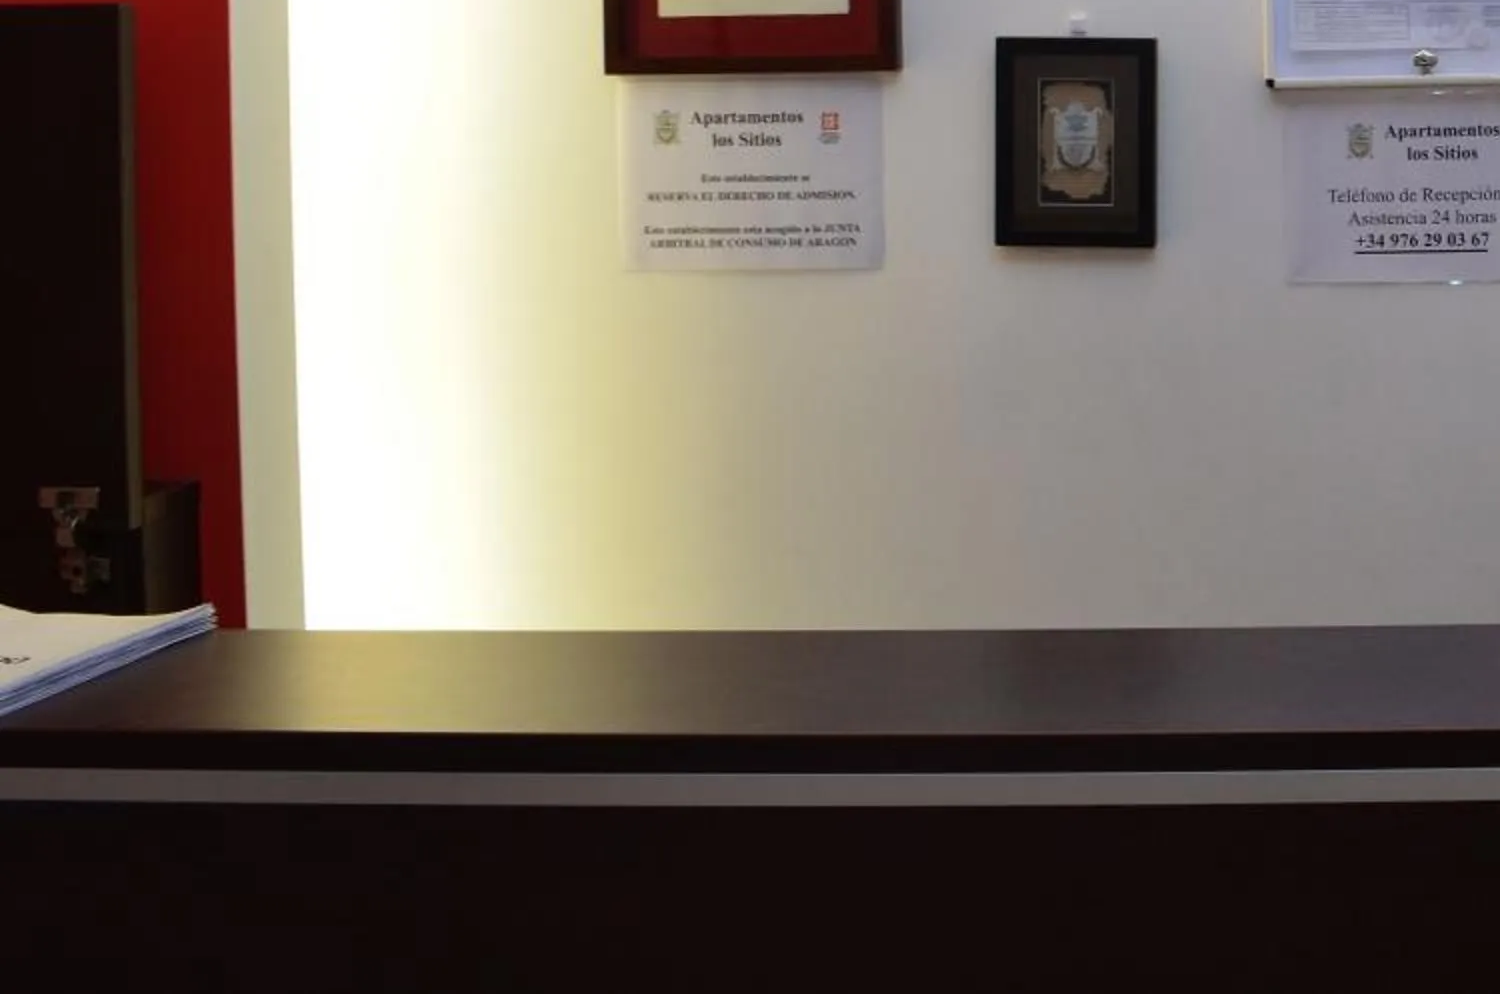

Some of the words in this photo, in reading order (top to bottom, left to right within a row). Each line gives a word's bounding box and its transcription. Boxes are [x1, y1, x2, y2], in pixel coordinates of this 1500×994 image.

[690, 110, 804, 128] Apartamentos
[712, 133, 734, 147] los
[738, 132, 783, 147] Sitios
[1384, 124, 1500, 142] Apartamentos
[1406, 146, 1429, 161] los
[1433, 145, 1479, 161] Sitios
[717, 191, 775, 201] DERECHO
[777, 190, 792, 200] DE
[1328, 188, 1395, 204] Teléfono
[1399, 188, 1417, 203] de
[1348, 210, 1427, 226] Asistencia
[1432, 210, 1451, 224] 24
[1455, 209, 1497, 225] horas
[789, 237, 803, 247] DE
[1356, 234, 1385, 248] +34
[1390, 233, 1419, 248] 976
[1424, 233, 1442, 248] 29
[1447, 232, 1466, 247] 03
[1471, 231, 1490, 247] 67
